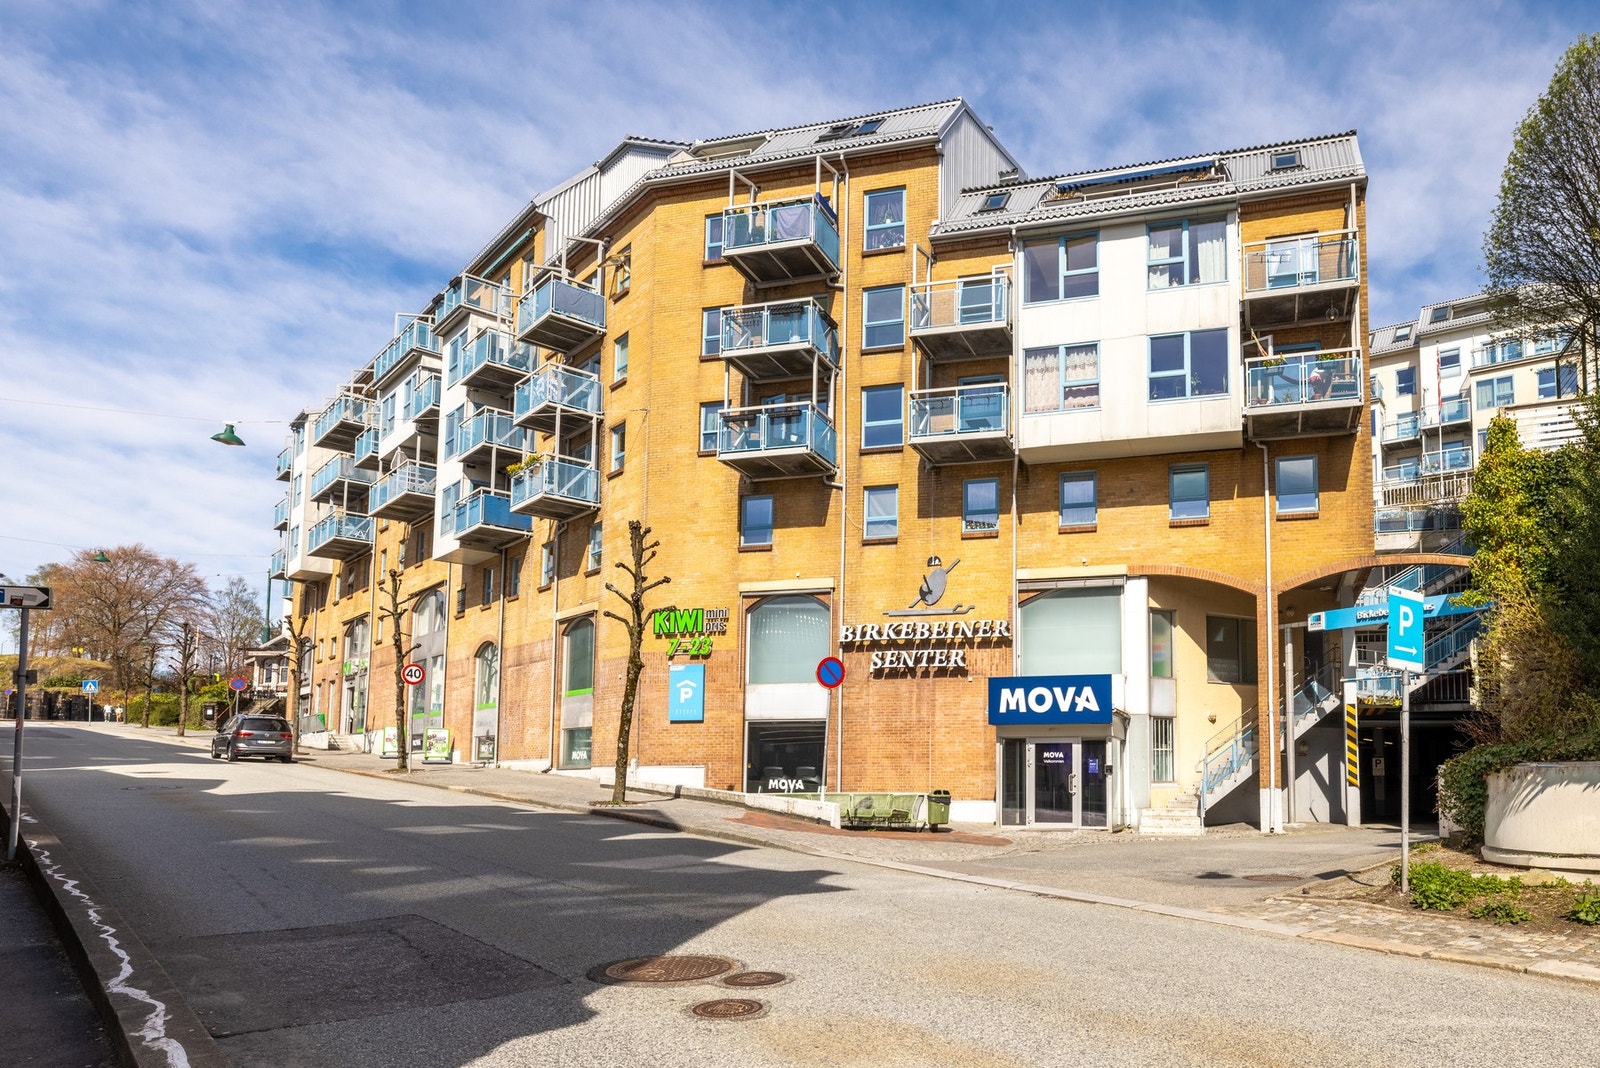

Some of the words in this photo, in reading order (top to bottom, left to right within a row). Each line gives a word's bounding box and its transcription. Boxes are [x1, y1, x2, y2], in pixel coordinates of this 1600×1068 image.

[705, 607, 728, 618] mini
[1356, 608, 1389, 620] Birkebe
[654, 608, 704, 634] KIWI
[705, 621, 726, 632] pris
[1399, 605, 1414, 636] P
[838, 620, 1011, 642] BIRKEBEINER
[871, 650, 966, 669] SENTER
[406, 669, 421, 679] 40
[680, 688, 693, 704] P
[999, 686, 1100, 713] MOVA
[1375, 759, 1382, 768] P
[768, 779, 804, 790] MOVA
